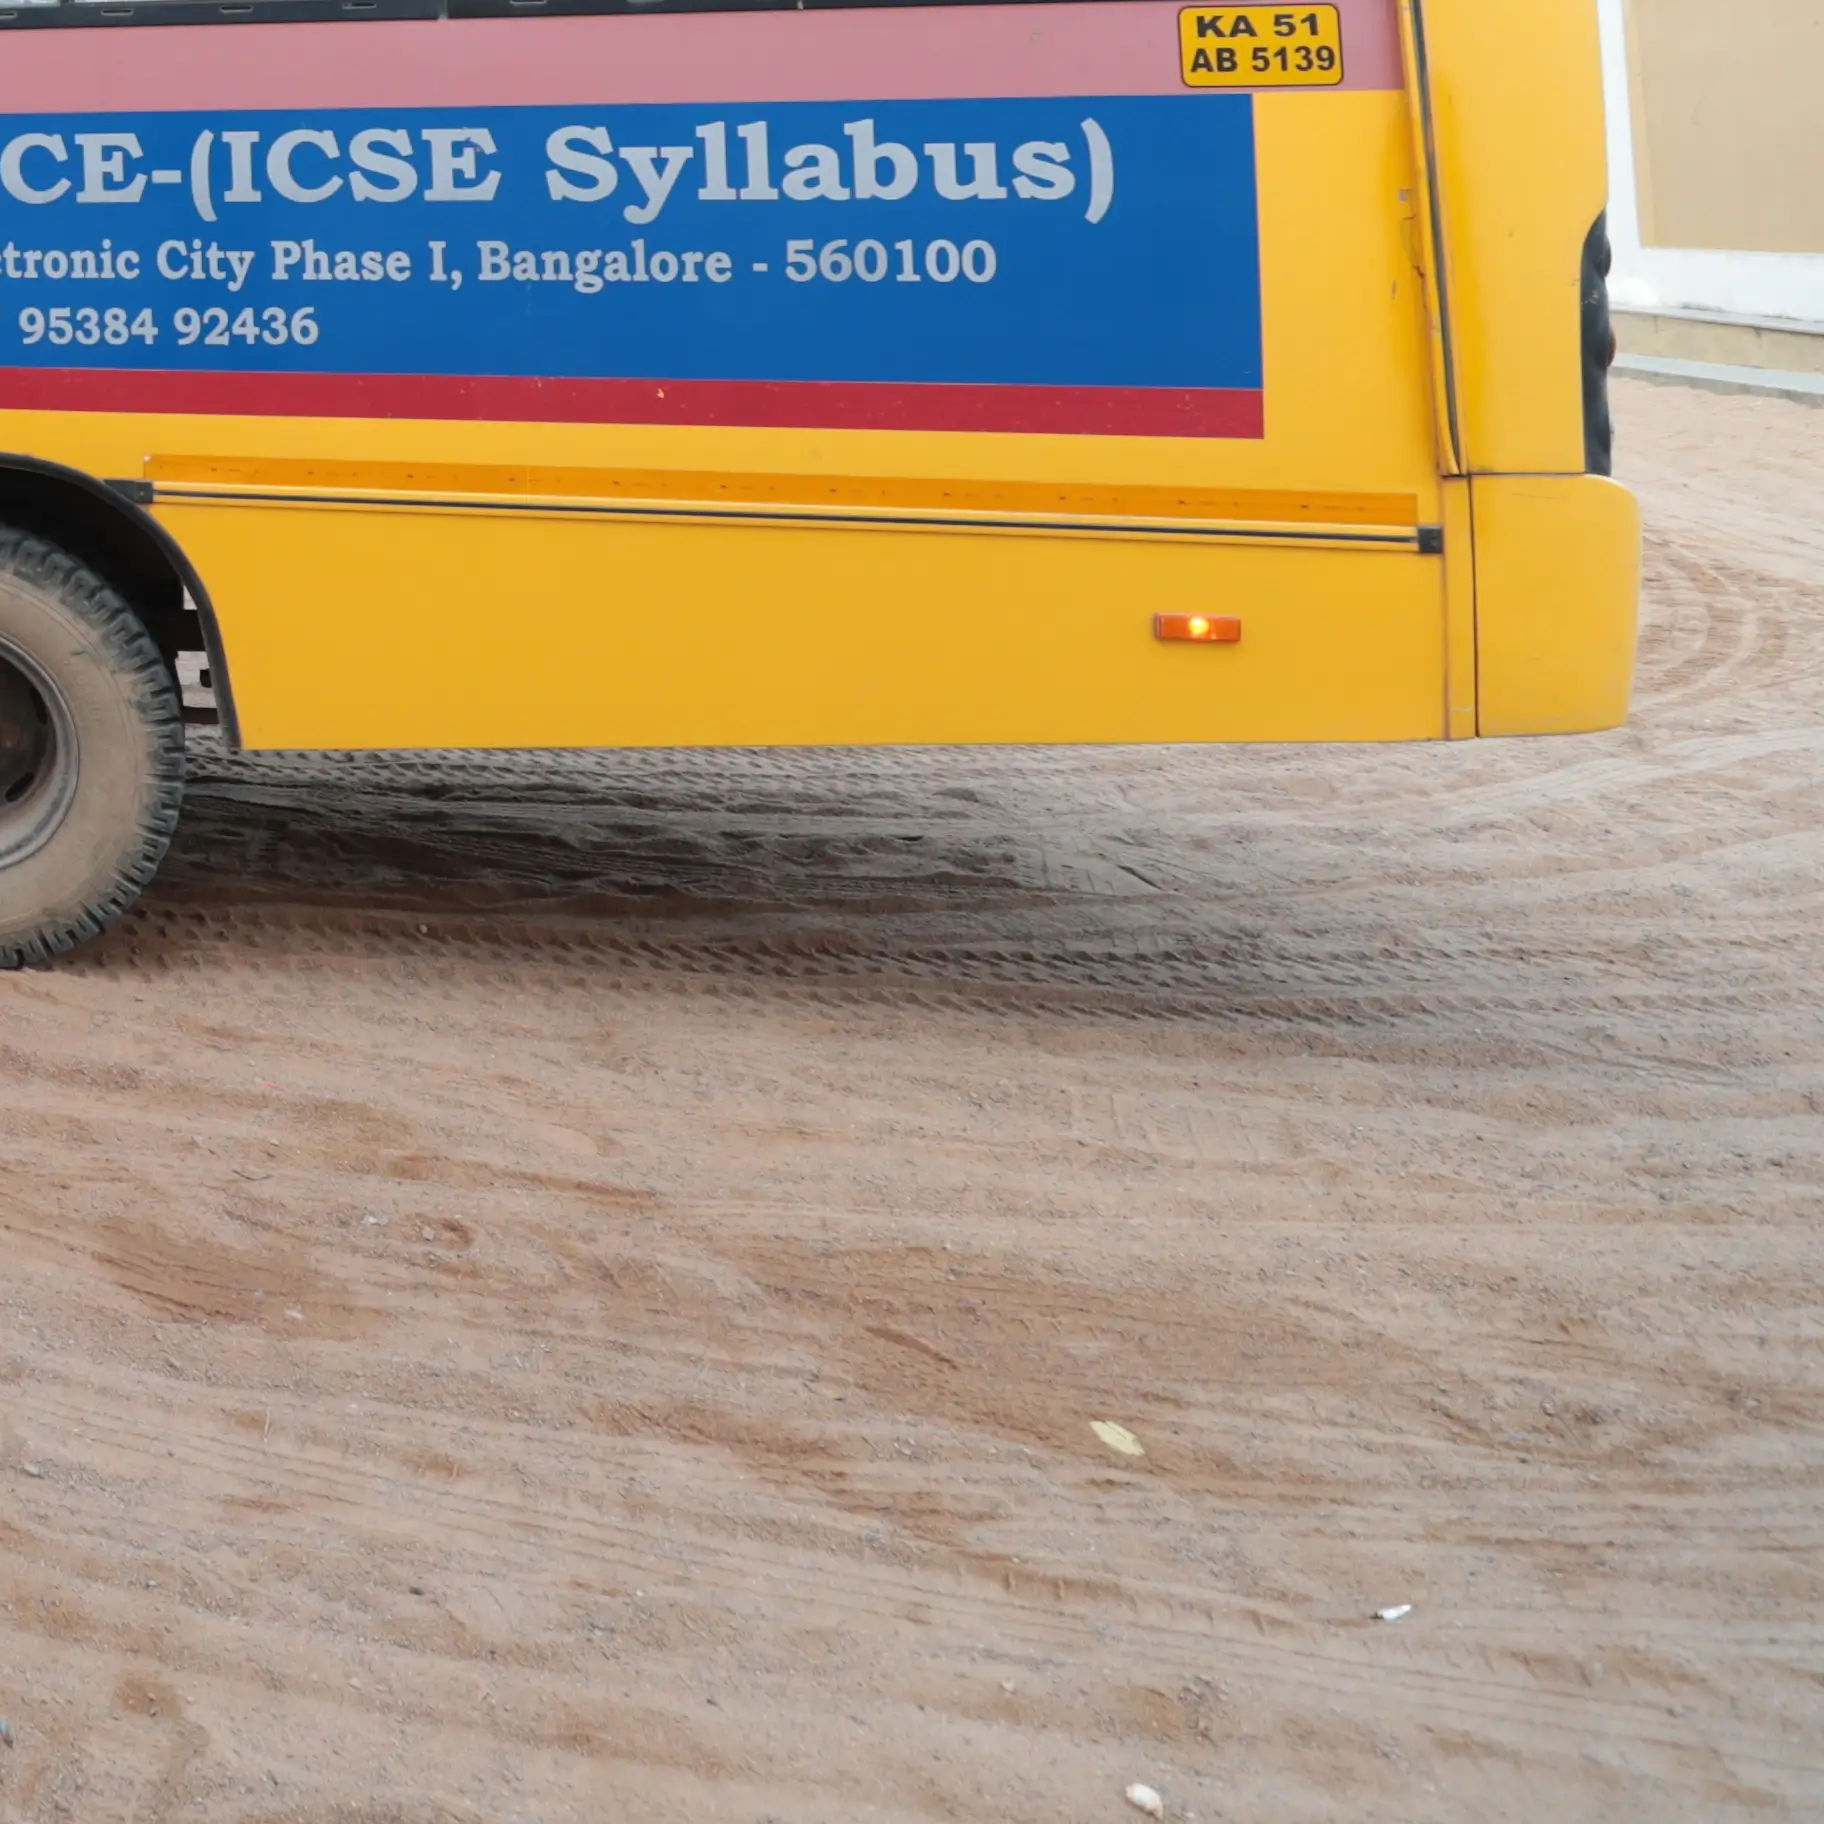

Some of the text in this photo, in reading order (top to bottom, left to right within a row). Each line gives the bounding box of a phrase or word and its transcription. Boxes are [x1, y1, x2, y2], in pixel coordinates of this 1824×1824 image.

[1196, 13, 1319, 38] KA 51
[1190, 45, 1335, 72] AB 5139
[546, 118, 1114, 224] Syllabus)
[157, 239, 255, 291] City
[271, 239, 411, 281] Phase
[429, 241, 462, 290] I,
[477, 239, 732, 293] Bangalore
[786, 239, 996, 282] 560100
[19, 307, 158, 344] 95384
[174, 307, 318, 345] 92436
